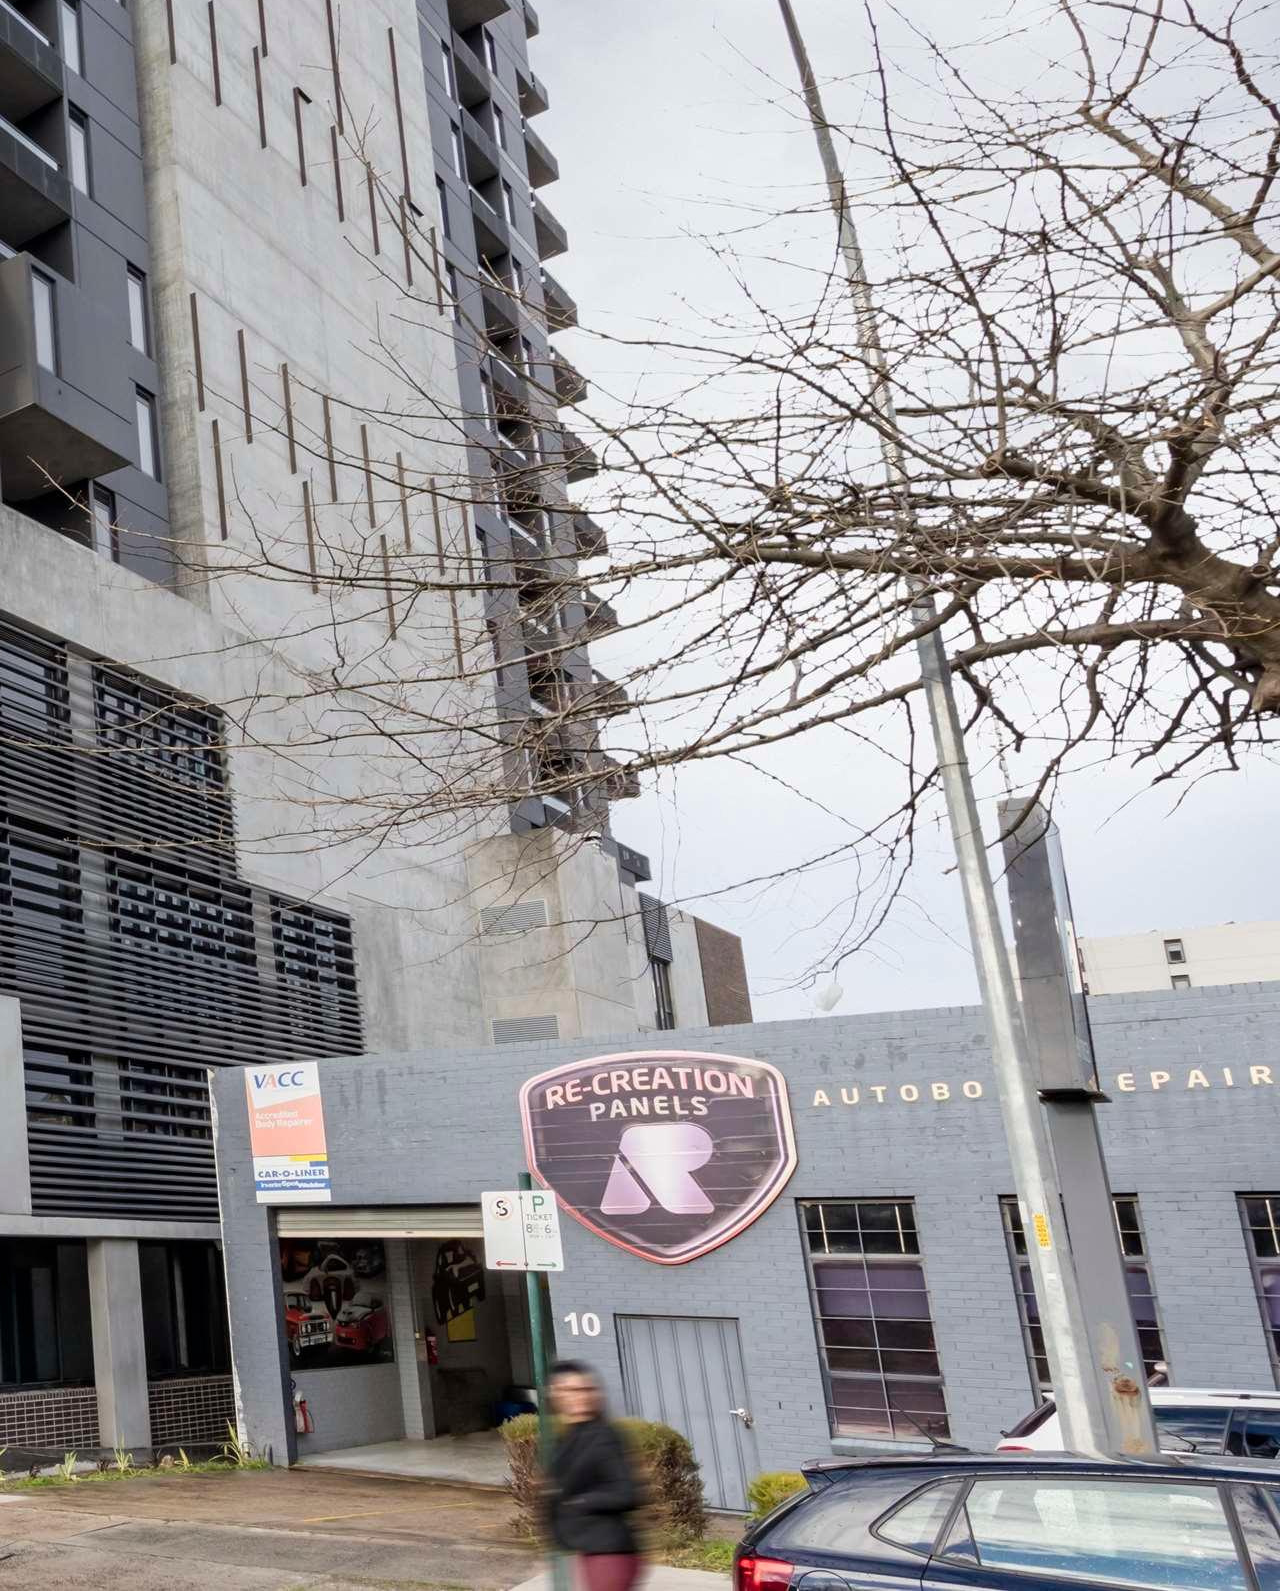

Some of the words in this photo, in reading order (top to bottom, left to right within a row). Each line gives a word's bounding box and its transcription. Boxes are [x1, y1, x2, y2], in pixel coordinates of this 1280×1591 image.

[253, 1070, 305, 1090] VACC
[545, 1066, 755, 1110] RE-CREATION
[812, 1080, 984, 1107] AUTOBO
[1116, 1064, 1275, 1092] EPAIR
[589, 1095, 709, 1122] PANELS
[526, 1213, 553, 1221] TICKET
[532, 1195, 545, 1213] P
[564, 1311, 601, 1337] 10
